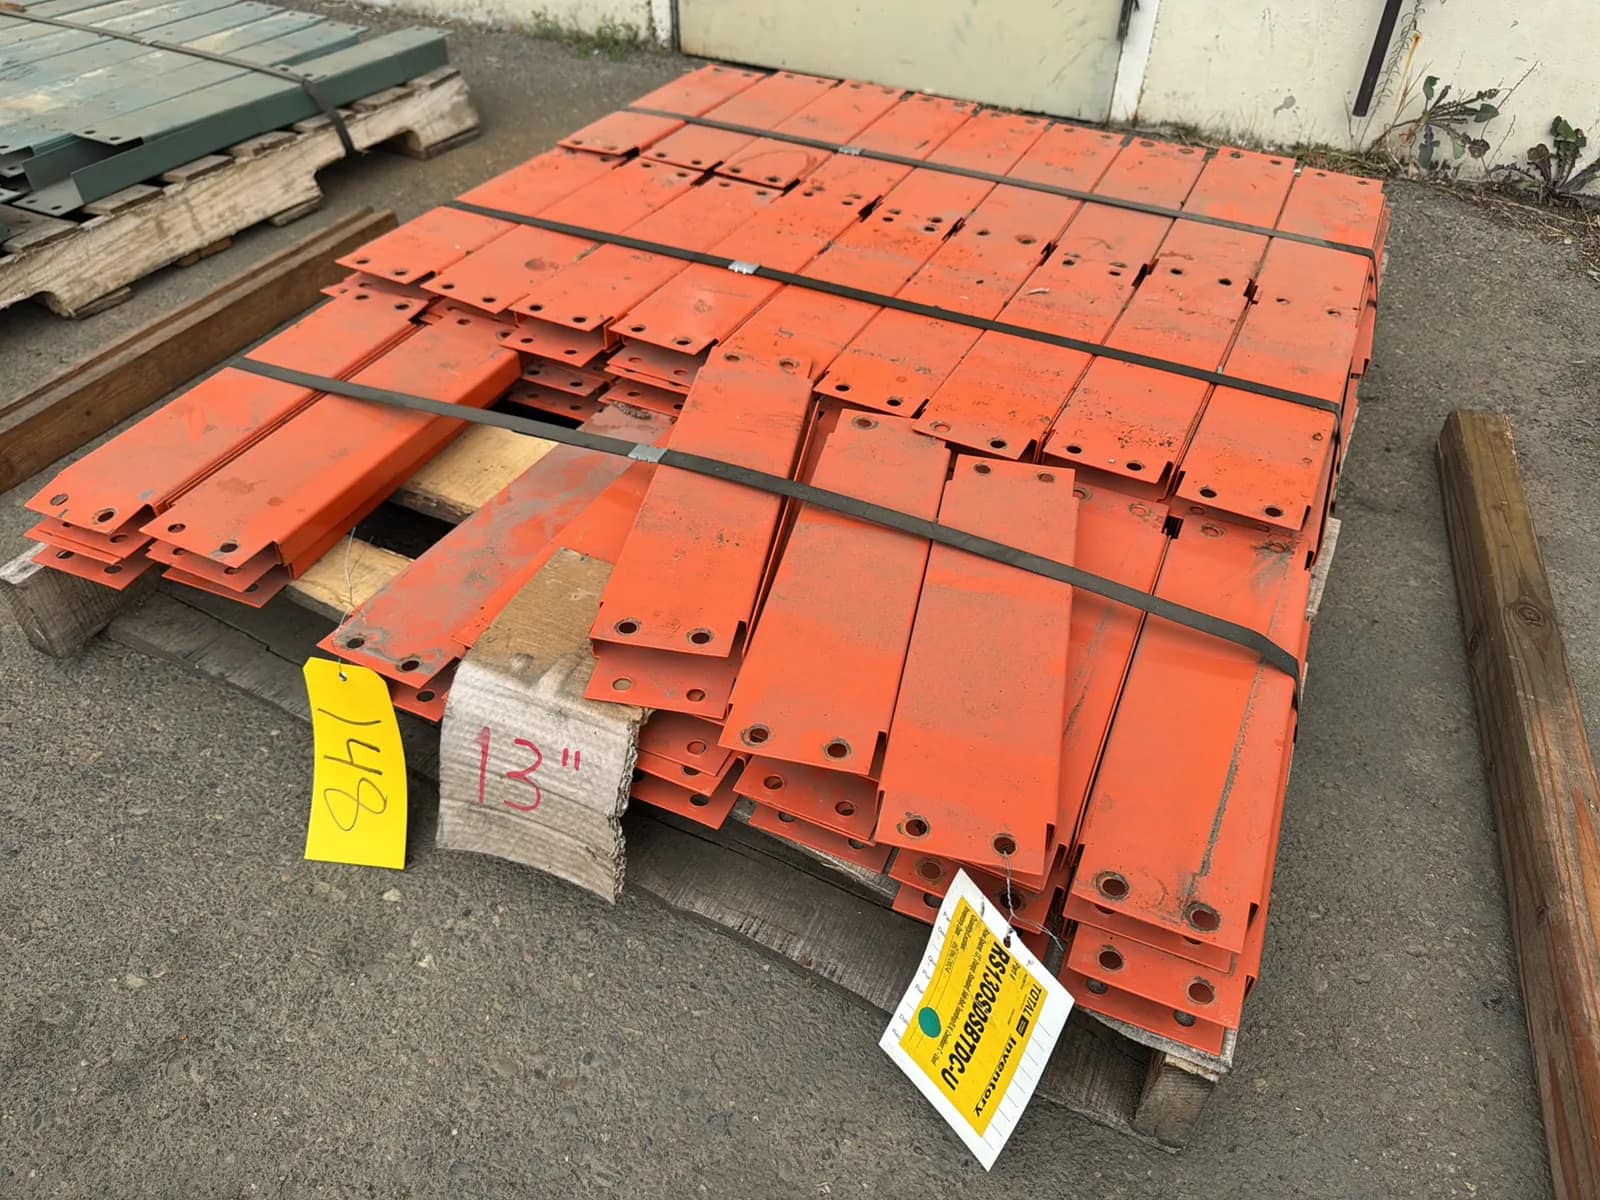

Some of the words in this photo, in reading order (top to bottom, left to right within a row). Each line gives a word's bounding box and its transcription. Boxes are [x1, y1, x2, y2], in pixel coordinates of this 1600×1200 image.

[317, 707, 388, 832] 148
[477, 726, 582, 812] 13"
[1022, 983, 1042, 1017] TOTAL
[974, 1037, 1017, 1118] Inventory
